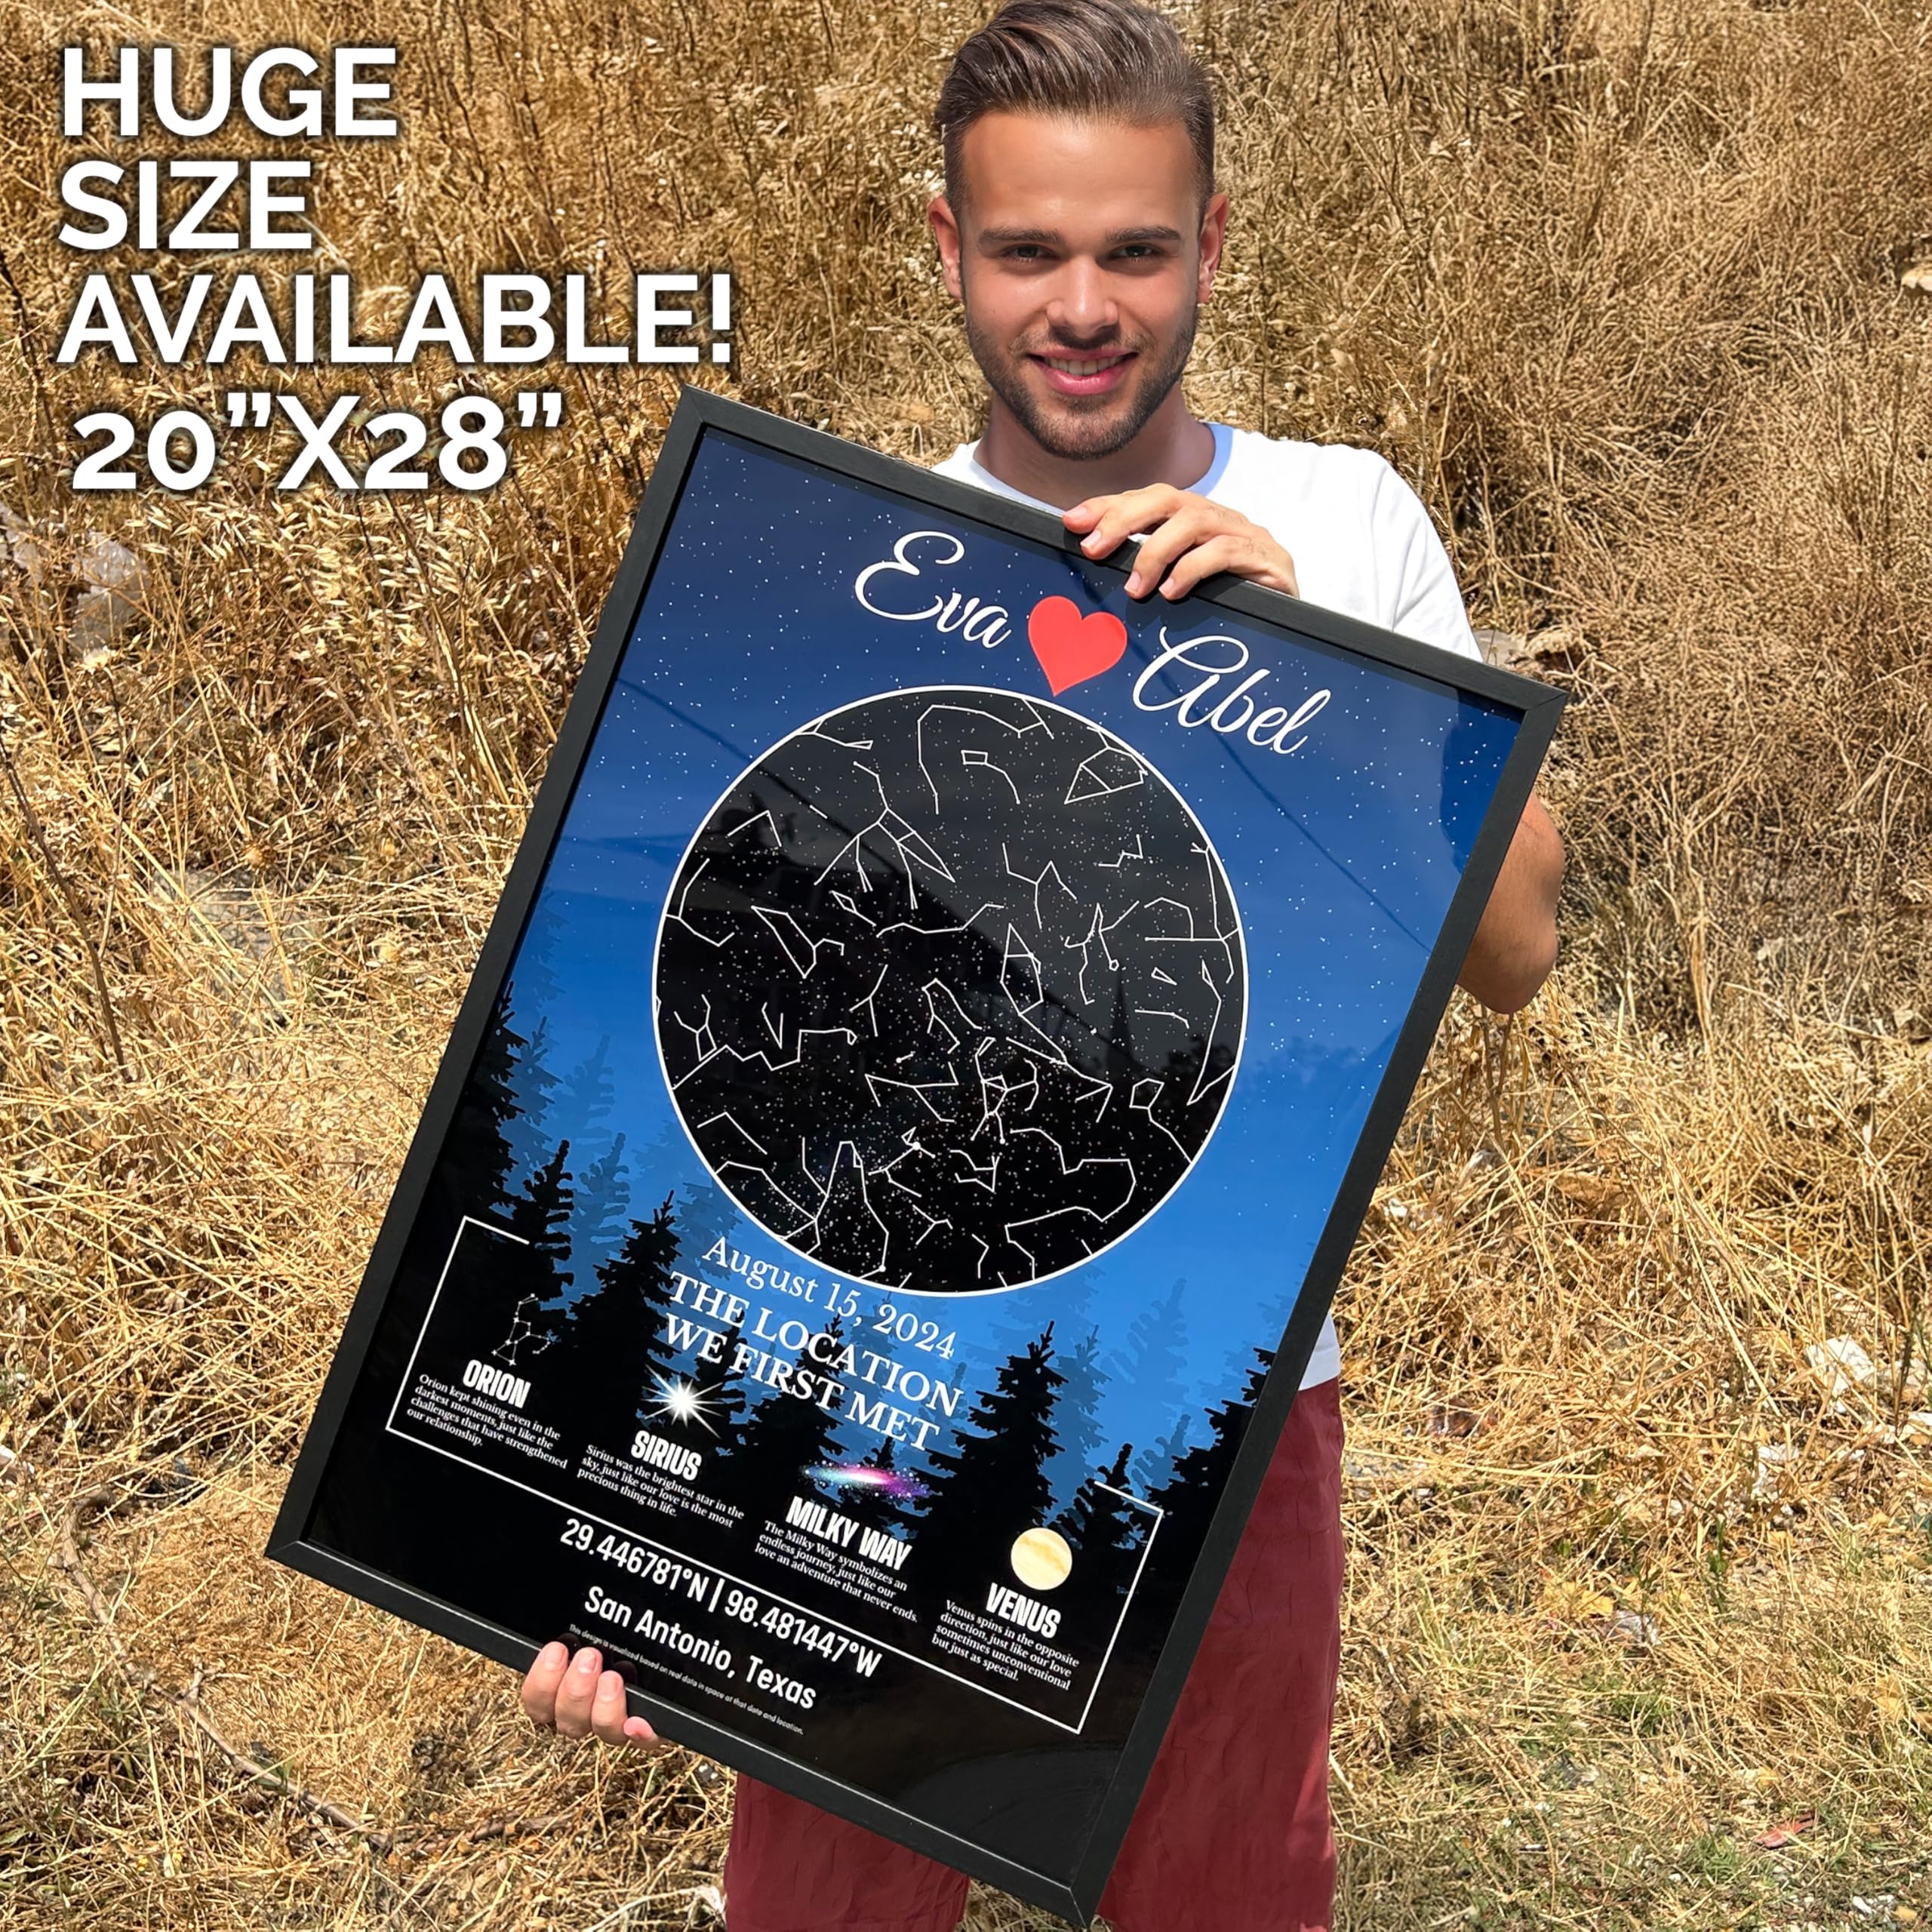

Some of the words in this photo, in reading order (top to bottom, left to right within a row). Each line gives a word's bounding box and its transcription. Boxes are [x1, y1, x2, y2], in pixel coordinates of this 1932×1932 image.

[854, 531, 1011, 648] Eva
[1132, 626, 1331, 754] Abel
[703, 1237, 817, 1302] August
[824, 1284, 861, 1326] 15,
[872, 1304, 955, 1358] 2024
[670, 1272, 749, 1327] THE
[752, 1308, 963, 1416] LOCATION
[419, 1374, 448, 1392] Orion
[449, 1386, 470, 1401] kept
[471, 1396, 507, 1421] shining
[508, 1414, 531, 1428] even
[532, 1421, 543, 1432] in
[544, 1427, 560, 1440] the
[463, 1359, 531, 1408] ORION
[666, 1313, 727, 1363] WE
[729, 1343, 844, 1410] FIRST
[845, 1392, 940, 1451] MET
[407, 1408, 425, 1420] our
[425, 1416, 481, 1446] relationship.
[411, 1397, 459, 1423] challenges
[460, 1417, 480, 1431] that
[481, 1424, 503, 1441] have
[505, 1437, 568, 1469] strengthened
[415, 1386, 449, 1405] darkest
[451, 1400, 497, 1427] moments,
[496, 1417, 516, 1434] just
[518, 1427, 536, 1441] like
[537, 1437, 553, 1449] the
[586, 1444, 614, 1463] Sirius
[616, 1459, 632, 1472] was
[635, 1466, 651, 1478] the
[652, 1472, 694, 1498] brightest
[696, 1494, 715, 1506] star
[715, 1500, 726, 1512] in
[728, 1506, 744, 1518] the
[631, 1430, 701, 1481] SIRIUS
[577, 1469, 619, 1491] precious
[620, 1485, 646, 1505] thing
[647, 1497, 657, 1508] in
[658, 1501, 676, 1516] life.
[582, 1457, 599, 1472] sky,
[599, 1464, 620, 1478] just
[620, 1472, 638, 1486] like
[640, 1483, 657, 1494] our
[659, 1488, 680, 1504] love
[681, 1498, 689, 1509] is
[691, 1503, 707, 1515] the
[708, 1512, 733, 1527] most
[759, 1534, 795, 1555] endless
[795, 1548, 835, 1574] journey,
[835, 1565, 856, 1584] just
[857, 1574, 875, 1590] like
[877, 1586, 896, 1598] our
[765, 1520, 783, 1537] The
[785, 1530, 814, 1551] Milky
[817, 1543, 837, 1561] Way
[838, 1555, 893, 1584] symbolizes
[894, 1580, 907, 1591] an
[786, 1496, 859, 1547] MILKY
[858, 1527, 912, 1570] WAY
[560, 1518, 709, 1601] 29.446781°N
[724, 1589, 881, 1677] 98.481447°W
[755, 1543, 776, 1559] love
[777, 1555, 789, 1565] an
[790, 1558, 841, 1587] adventure
[841, 1582, 861, 1597] that
[863, 1592, 892, 1610] never
[892, 1606, 916, 1622] ends.
[986, 1583, 1061, 1638] VENUS
[585, 1586, 632, 1627] San
[634, 1610, 734, 1678] Antonio,
[746, 1655, 816, 1709] Texas
[931, 1633, 949, 1649] but
[948, 1642, 969, 1658] just
[970, 1654, 980, 1663] as
[983, 1660, 1018, 1681] special.
[936, 1625, 990, 1654] sometimes
[992, 1650, 1070, 1690] unconventional
[940, 1613, 988, 1643] direction,
[987, 1633, 1008, 1649] just
[1009, 1642, 1029, 1658] like
[1029, 1654, 1049, 1666] our
[1049, 1660, 1071, 1677] love
[946, 1599, 974, 1620] Venus
[977, 1617, 1002, 1635] spins
[1004, 1626, 1015, 1639] in
[1017, 1633, 1034, 1647] the
[1035, 1643, 1078, 1666] opposite
